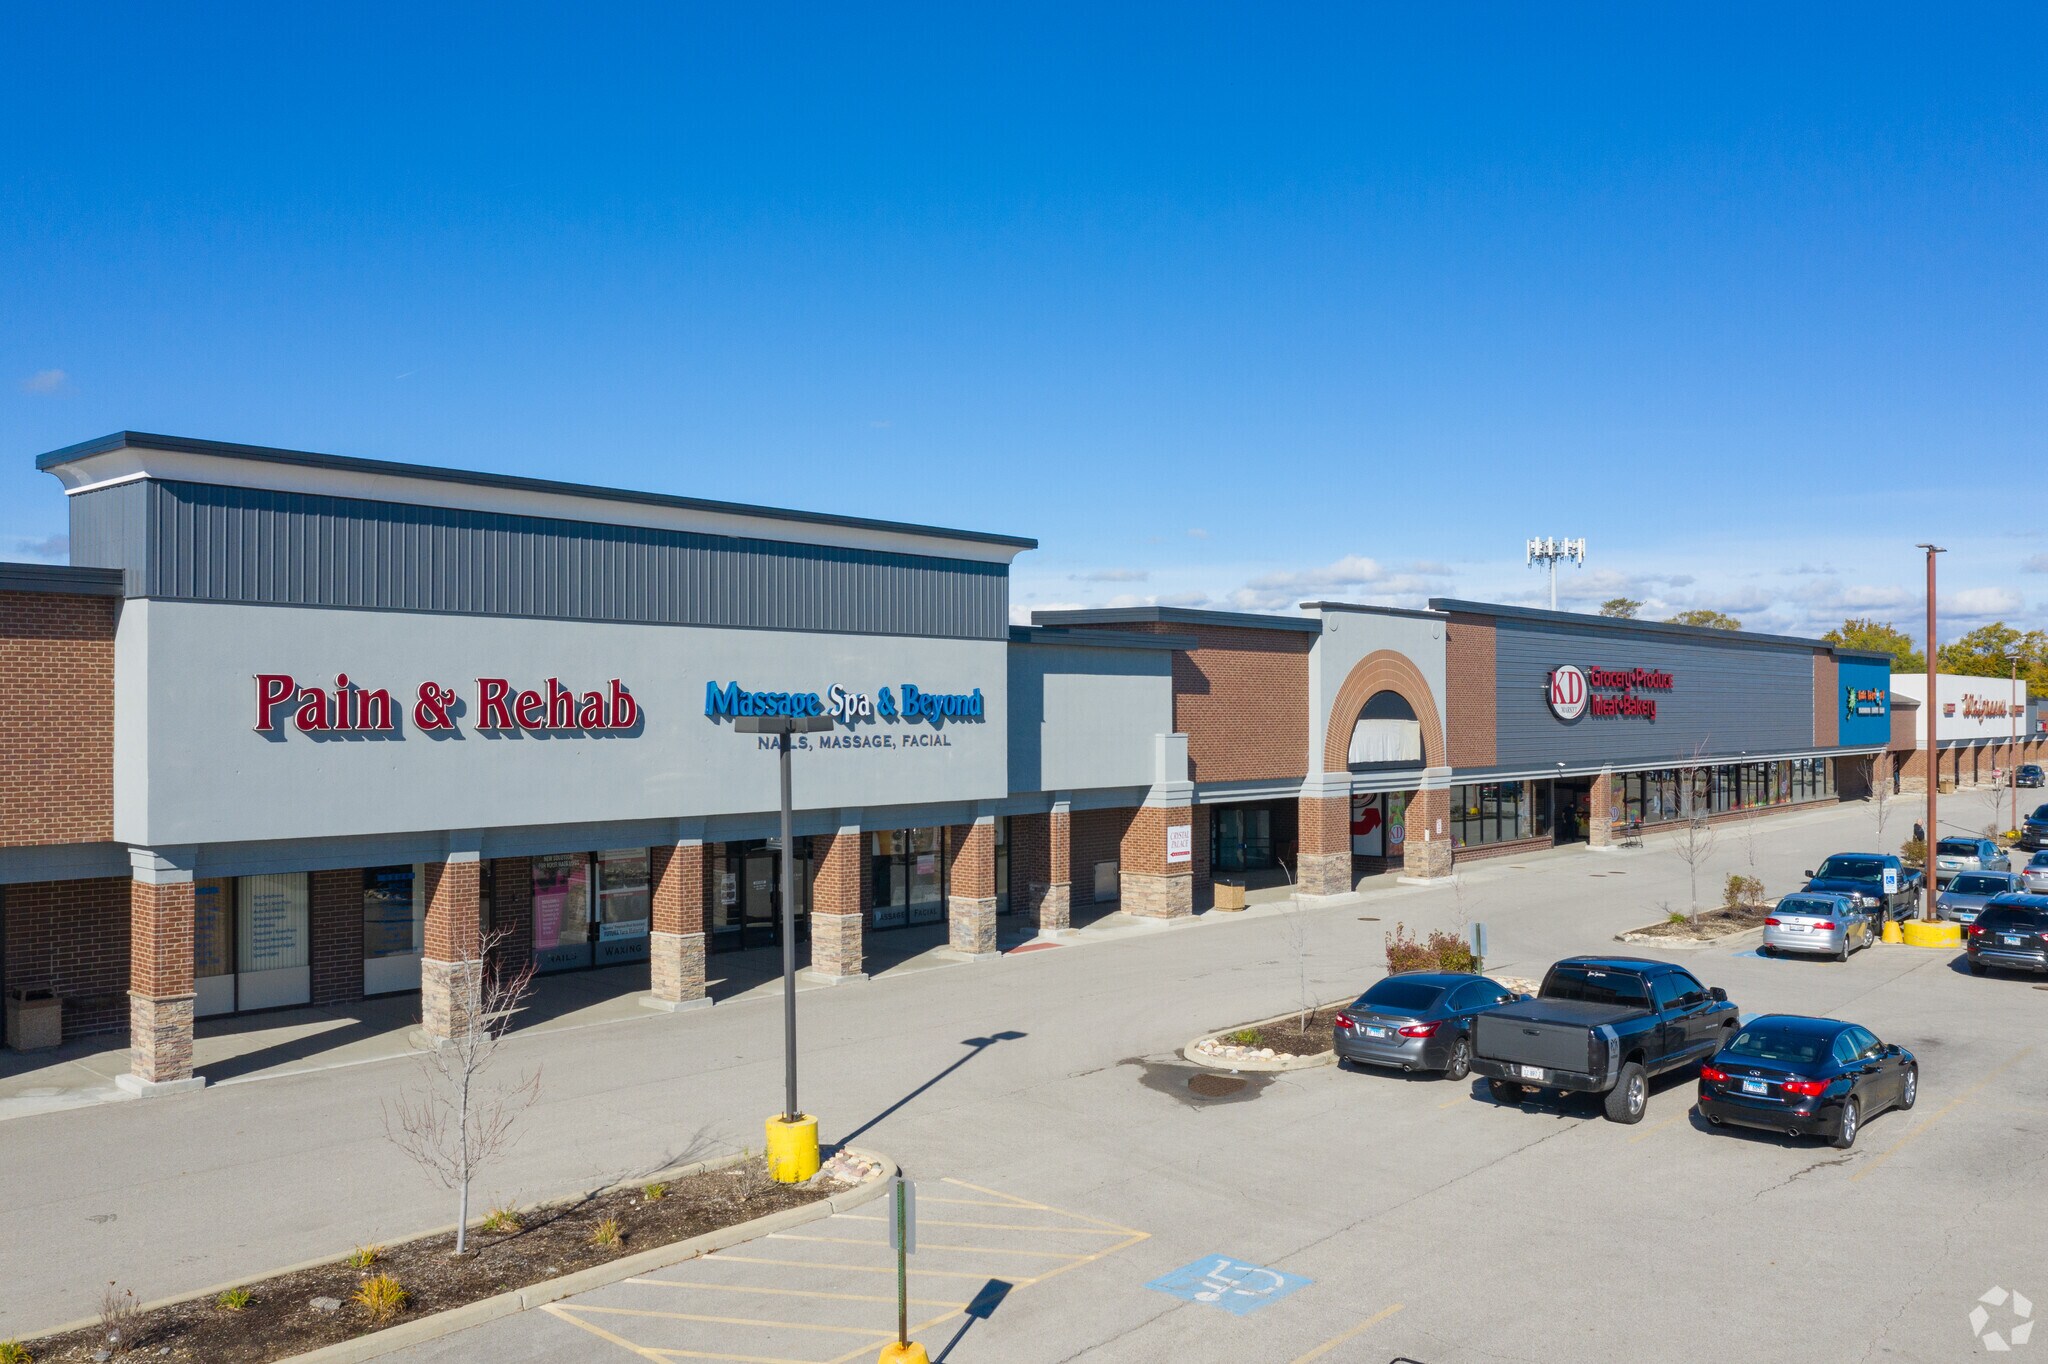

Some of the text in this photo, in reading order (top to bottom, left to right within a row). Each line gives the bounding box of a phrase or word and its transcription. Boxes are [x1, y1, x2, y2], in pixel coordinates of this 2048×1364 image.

[253, 673, 638, 731] Pain & Rehab
[704, 680, 982, 723] Massage Spa & Beyond
[1551, 671, 1583, 705] KD
[758, 733, 952, 752] NAS, MASSAGE, FACIAL
[604, 944, 642, 956] WAXING
